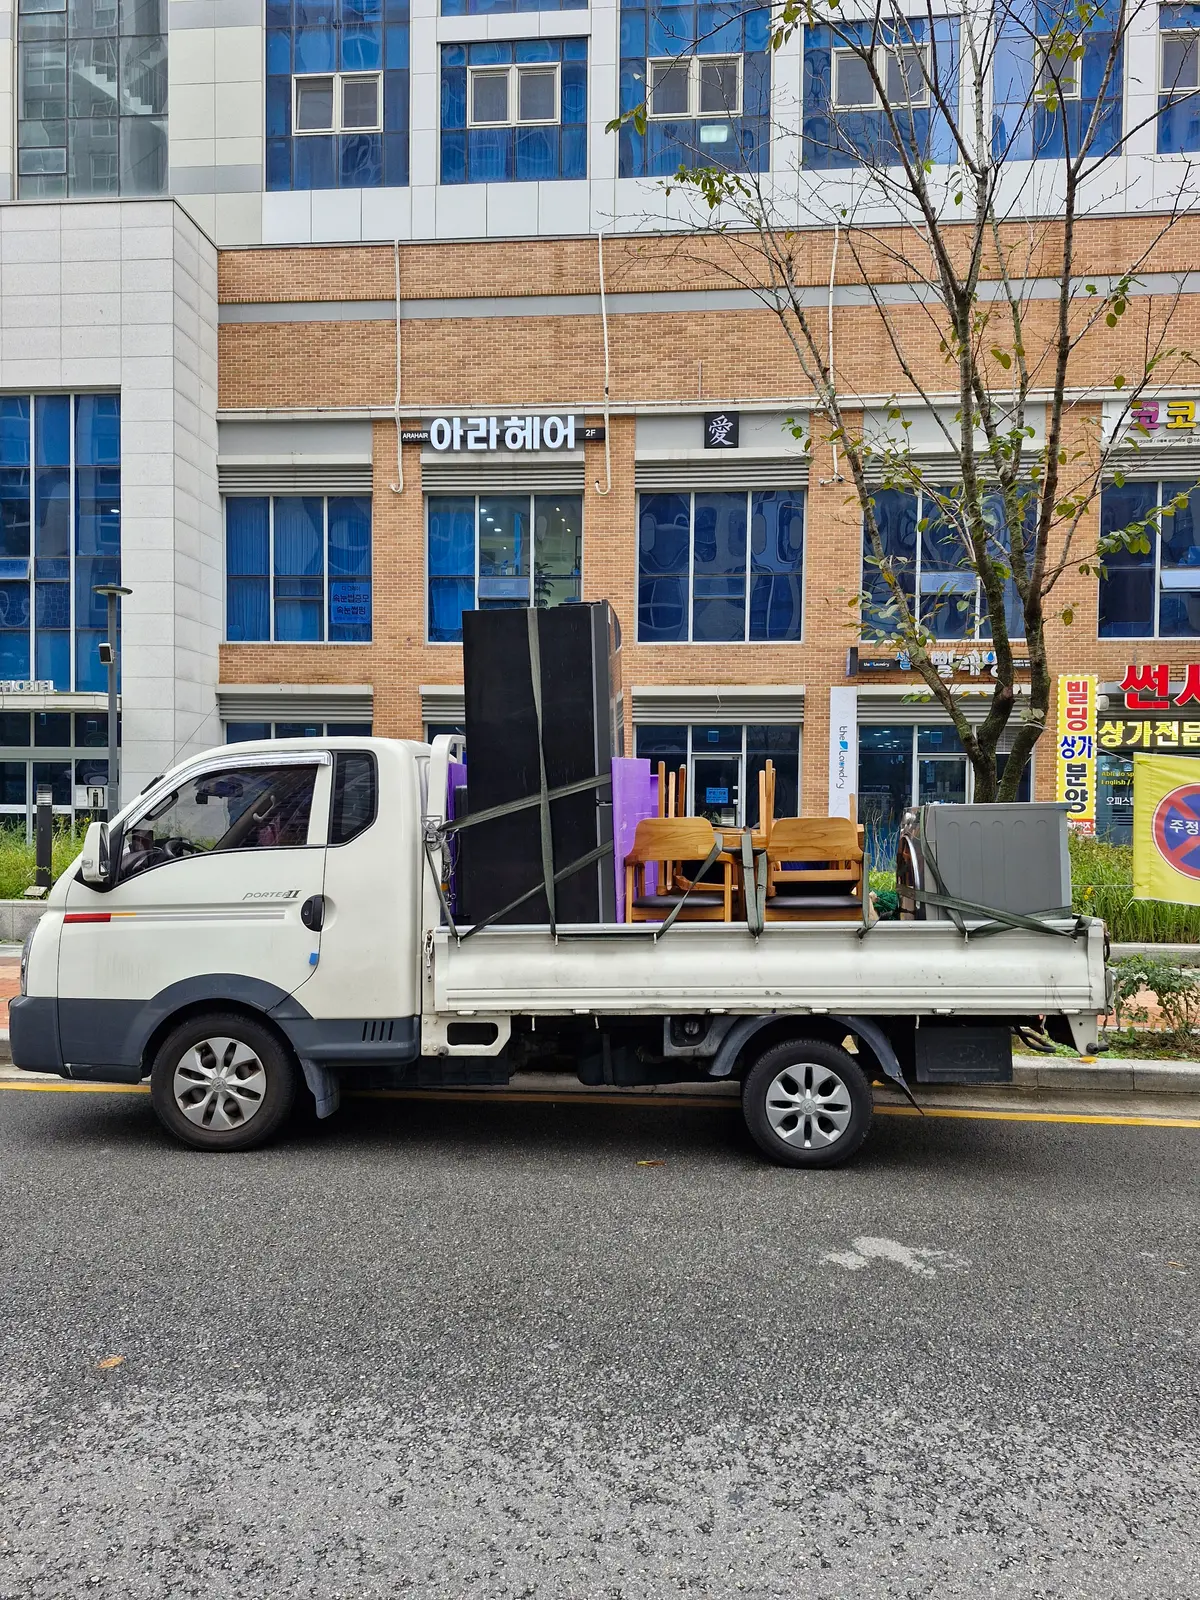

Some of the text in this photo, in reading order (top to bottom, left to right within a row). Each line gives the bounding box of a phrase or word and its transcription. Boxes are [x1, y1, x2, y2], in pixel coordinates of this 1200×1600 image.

[430, 415, 575, 451] 아라헤어
[585, 429, 596, 437] 2F
[708, 414, 735, 446] 愛
[1066, 680, 1089, 732] 빌딩
[1060, 736, 1094, 760] 상가
[1064, 762, 1089, 814] 분양
